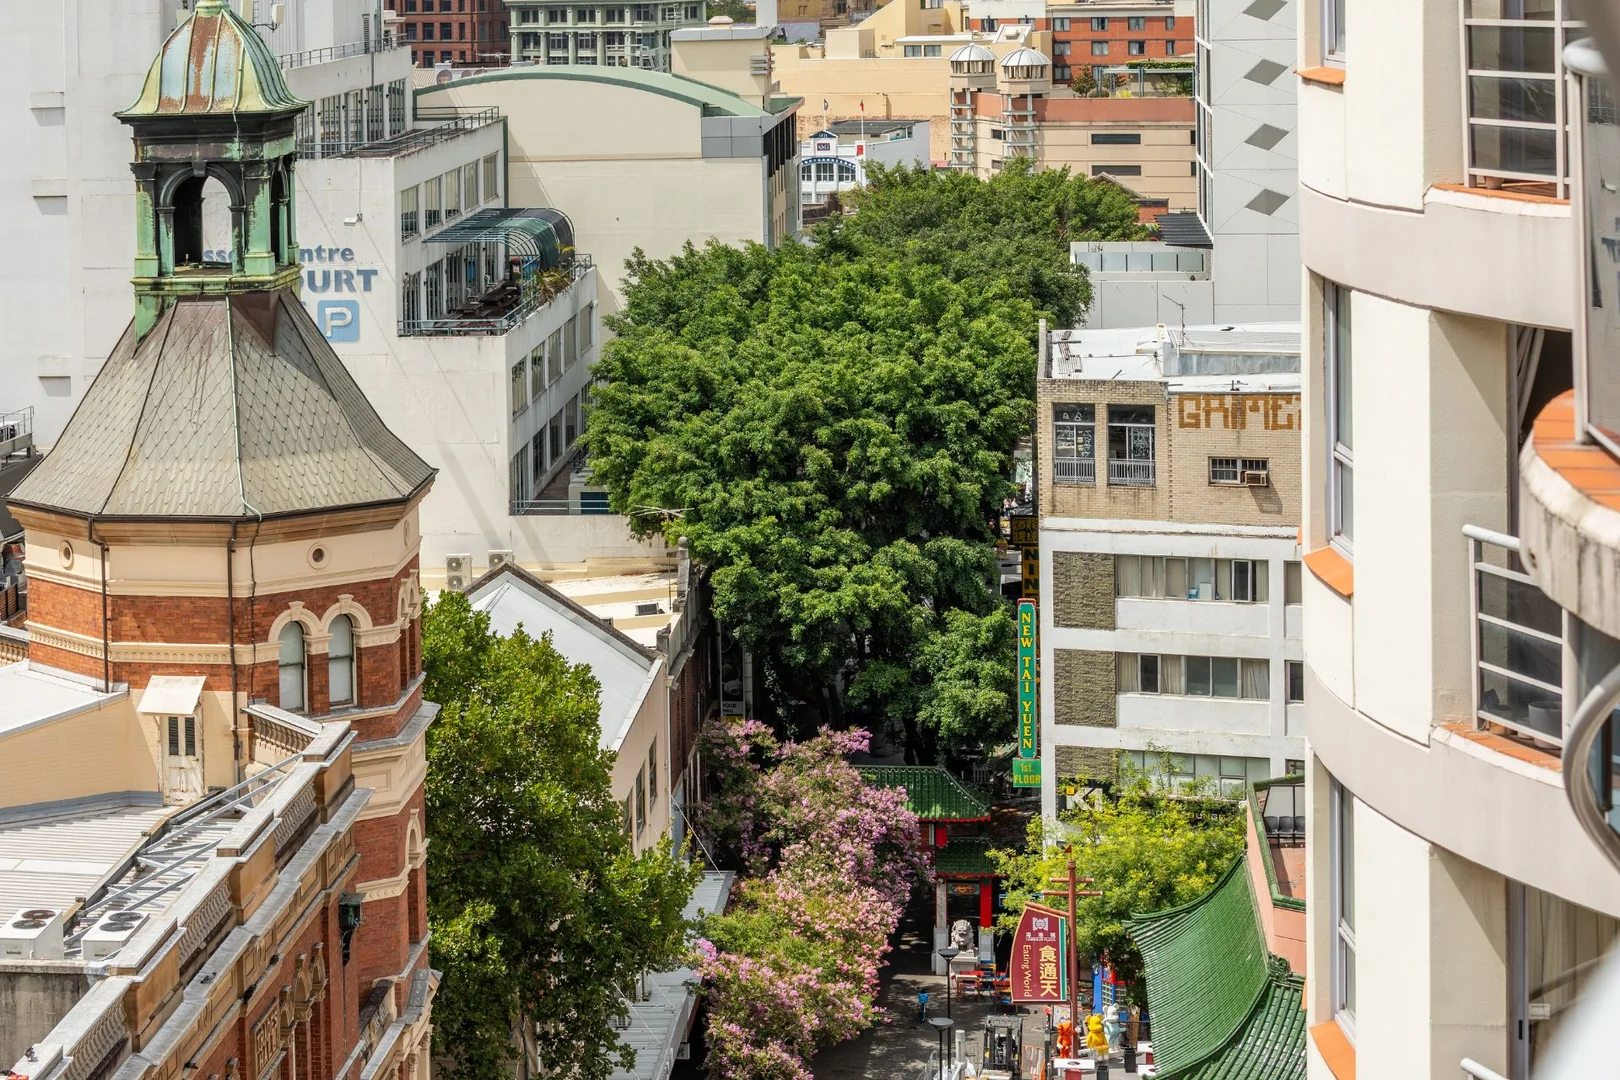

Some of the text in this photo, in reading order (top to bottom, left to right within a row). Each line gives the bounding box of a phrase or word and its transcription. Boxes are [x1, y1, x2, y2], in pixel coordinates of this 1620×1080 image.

[300, 269, 379, 293] URT
[325, 306, 353, 337] P
[1020, 612, 1033, 749] NEW TAI YUEN
[1013, 774, 1041, 784] FLOOR
[1021, 944, 1032, 997] Eating World
[1039, 945, 1058, 997] 食通天
